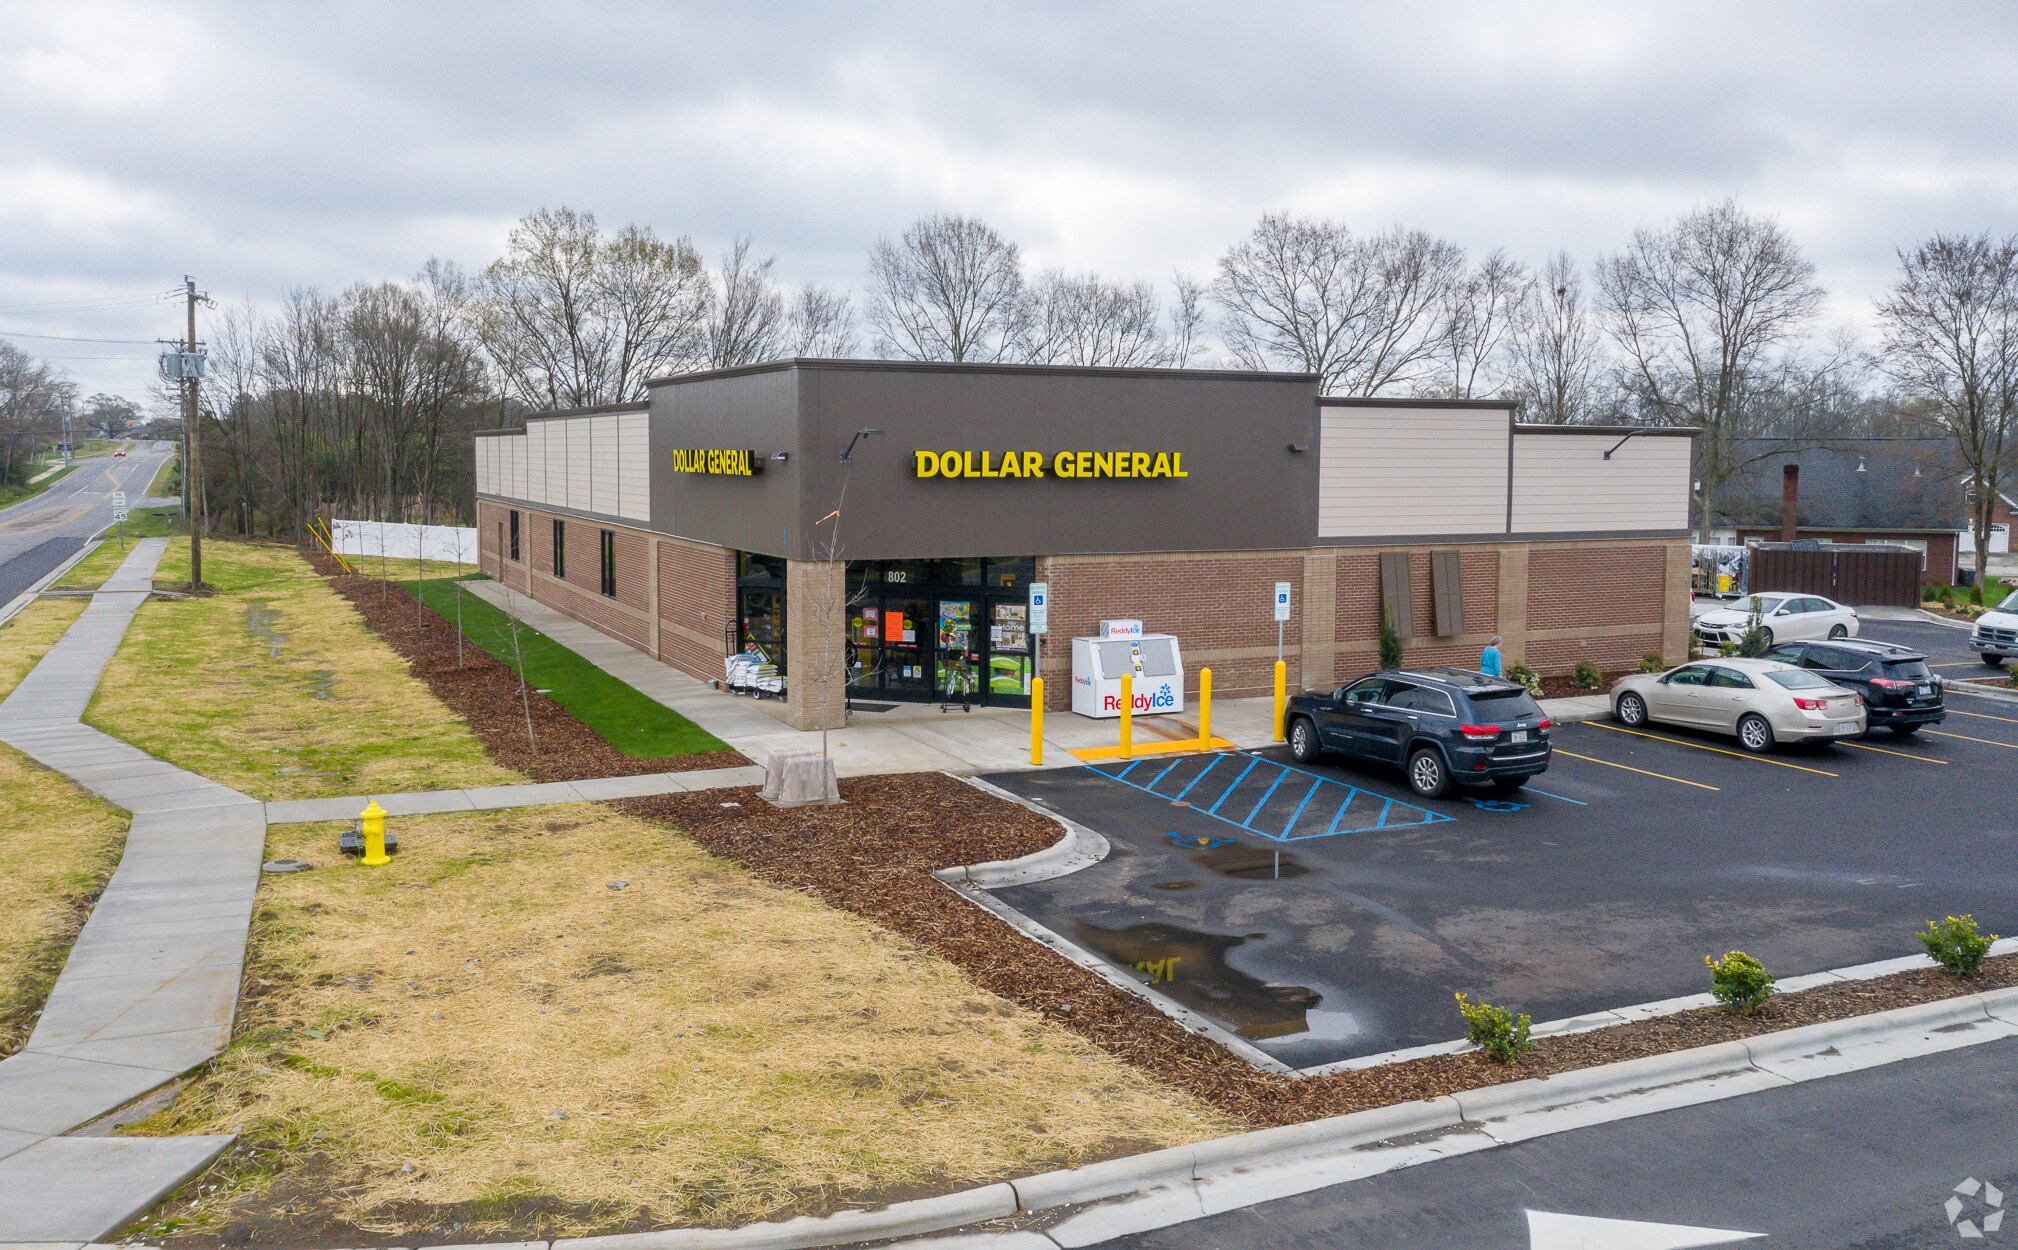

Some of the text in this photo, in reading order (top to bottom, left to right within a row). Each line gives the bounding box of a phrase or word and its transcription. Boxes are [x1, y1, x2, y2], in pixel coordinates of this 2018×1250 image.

[672, 449, 752, 476] DOLLAR GENERAL
[915, 450, 1189, 478] DOLLAR GENERAL
[888, 571, 906, 583] 802
